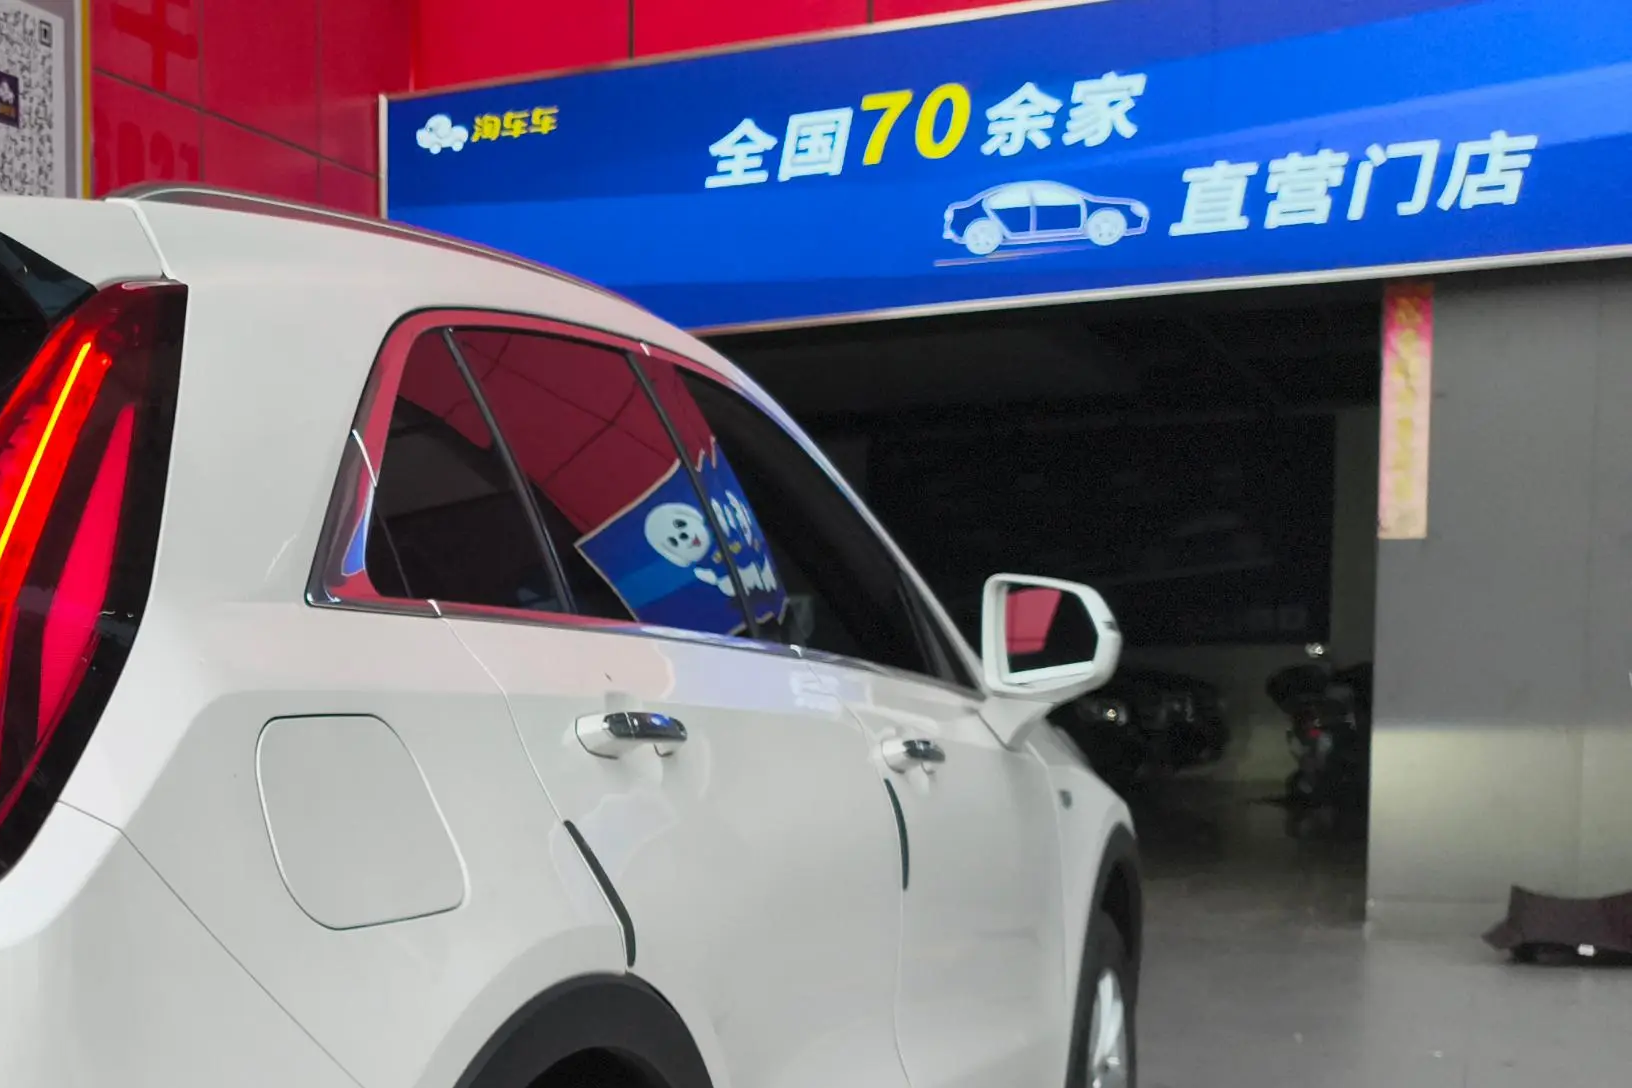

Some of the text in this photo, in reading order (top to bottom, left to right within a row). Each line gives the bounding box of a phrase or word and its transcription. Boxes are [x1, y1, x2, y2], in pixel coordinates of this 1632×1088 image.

[470, 105, 559, 143] 淘车车
[704, 71, 1148, 189] 全国70余家
[1169, 130, 1538, 237] 直营门店
